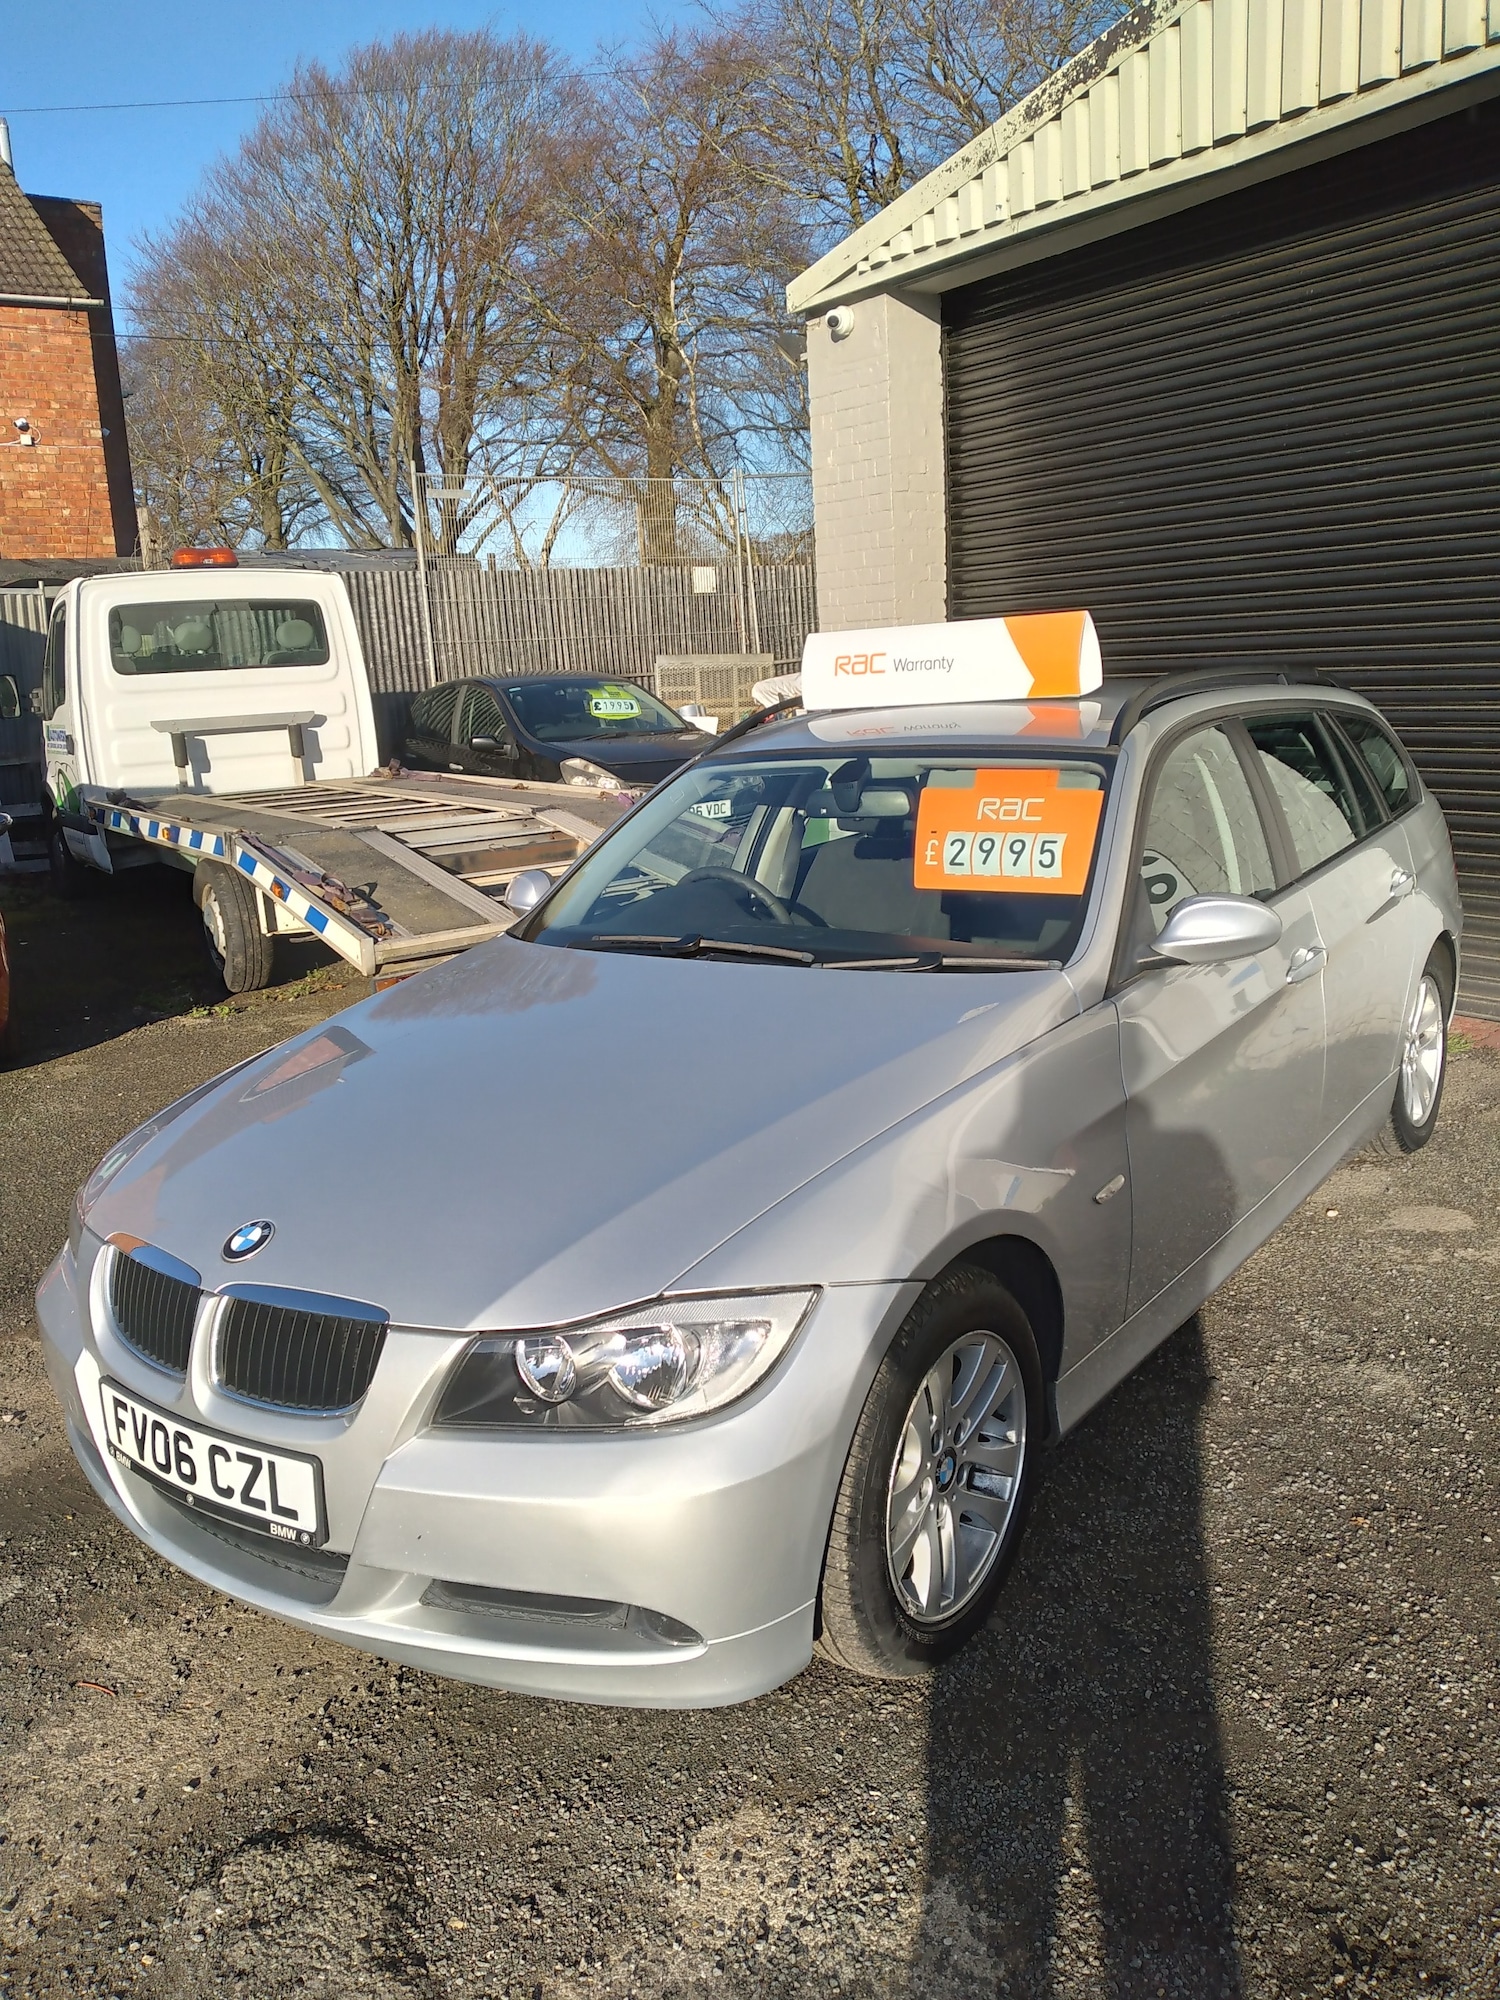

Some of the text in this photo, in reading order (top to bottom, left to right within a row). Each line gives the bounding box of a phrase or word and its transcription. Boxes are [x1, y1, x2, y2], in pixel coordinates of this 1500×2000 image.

[893, 656, 954, 673] Warranty
[706, 802, 727, 816] VDC
[112, 1395, 299, 1522] FV06 CZL
[115, 1450, 132, 1470] BMW
[270, 1522, 297, 1541] BMW
